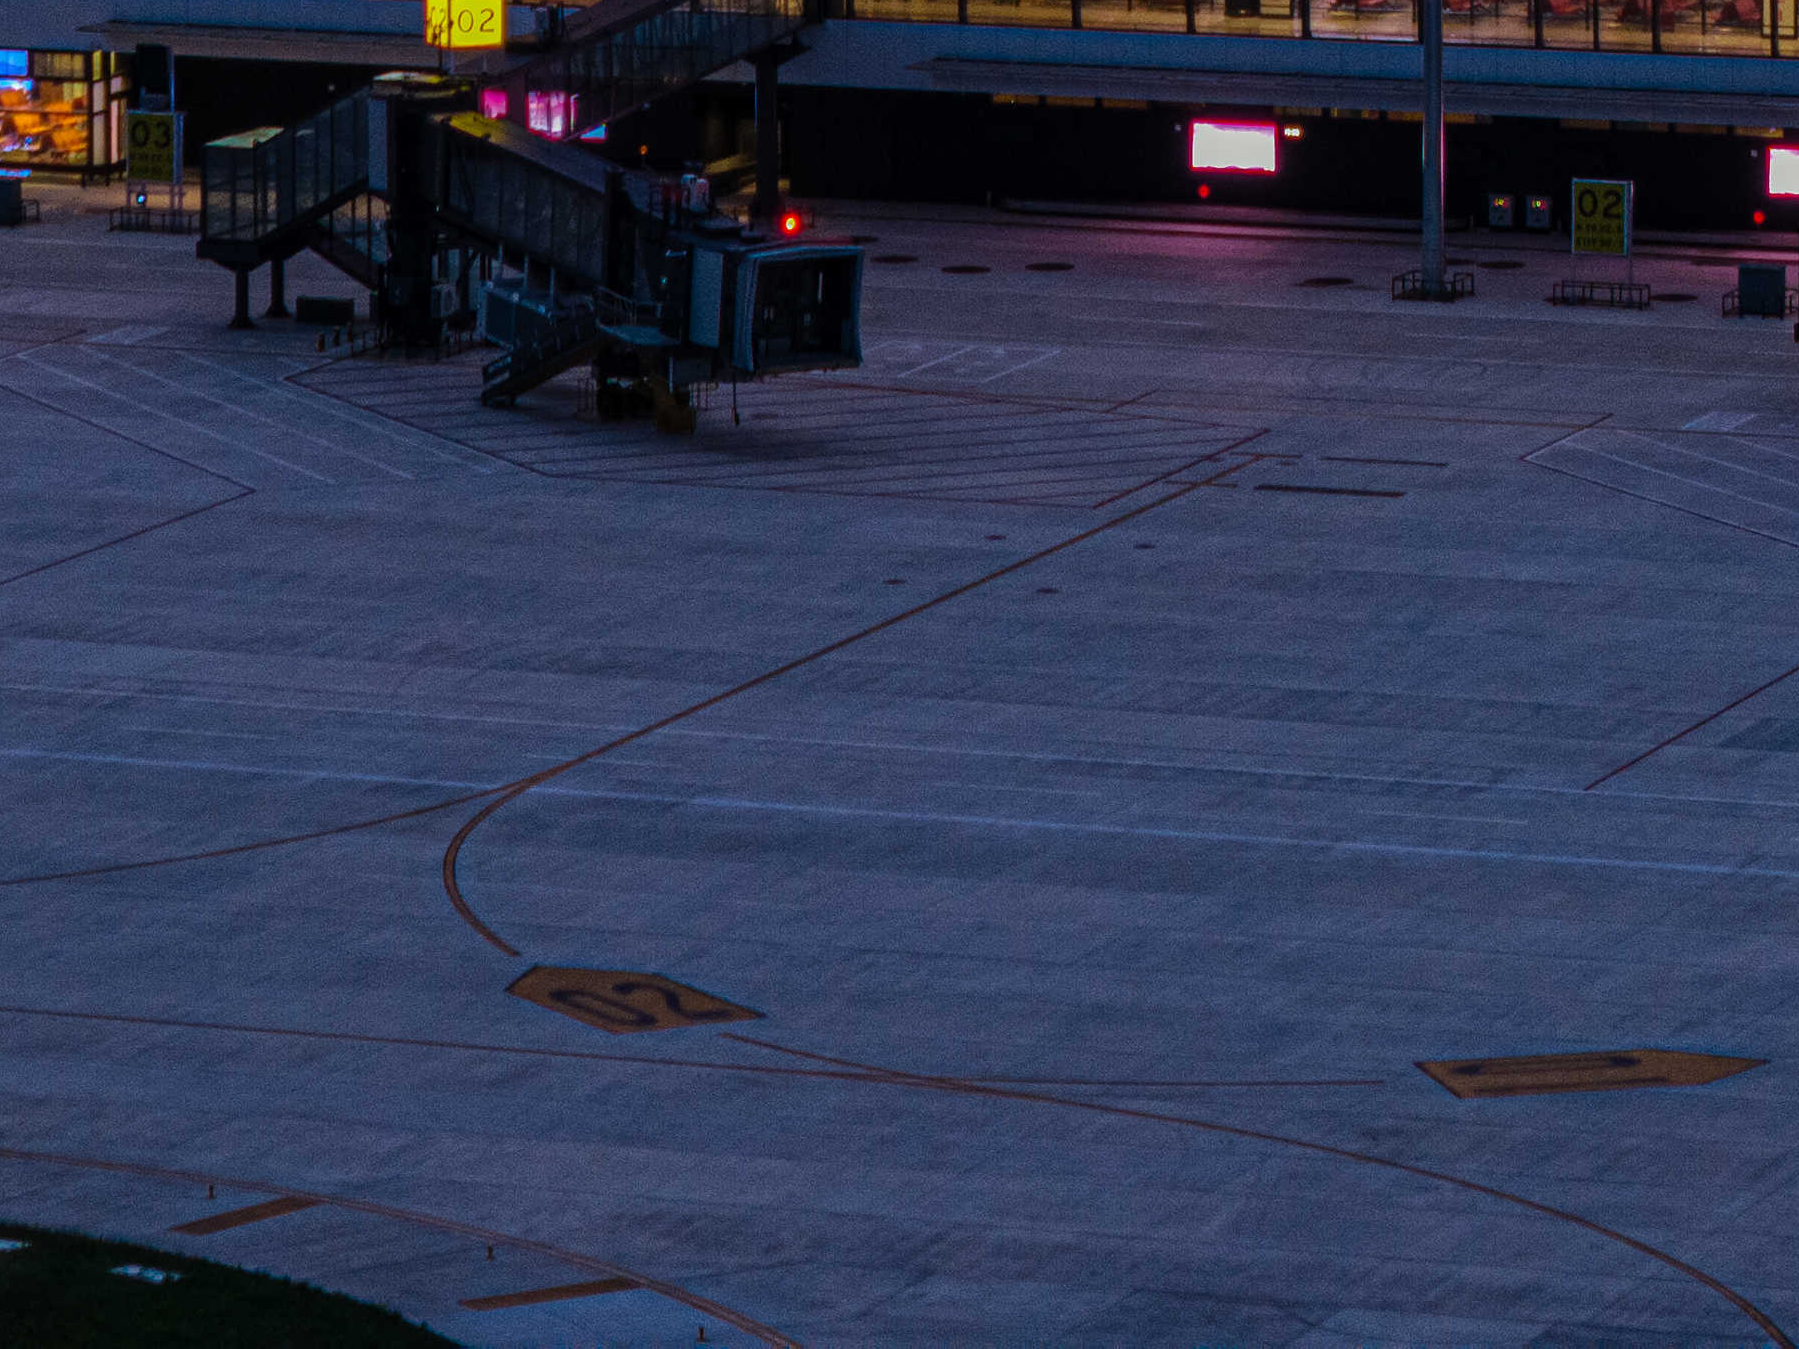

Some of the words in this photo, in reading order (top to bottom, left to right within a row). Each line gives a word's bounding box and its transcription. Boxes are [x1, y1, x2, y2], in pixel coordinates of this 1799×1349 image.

[457, 8, 495, 33] 02
[131, 119, 171, 149] 03
[1577, 188, 1621, 218] 02
[548, 982, 736, 1027] 02
